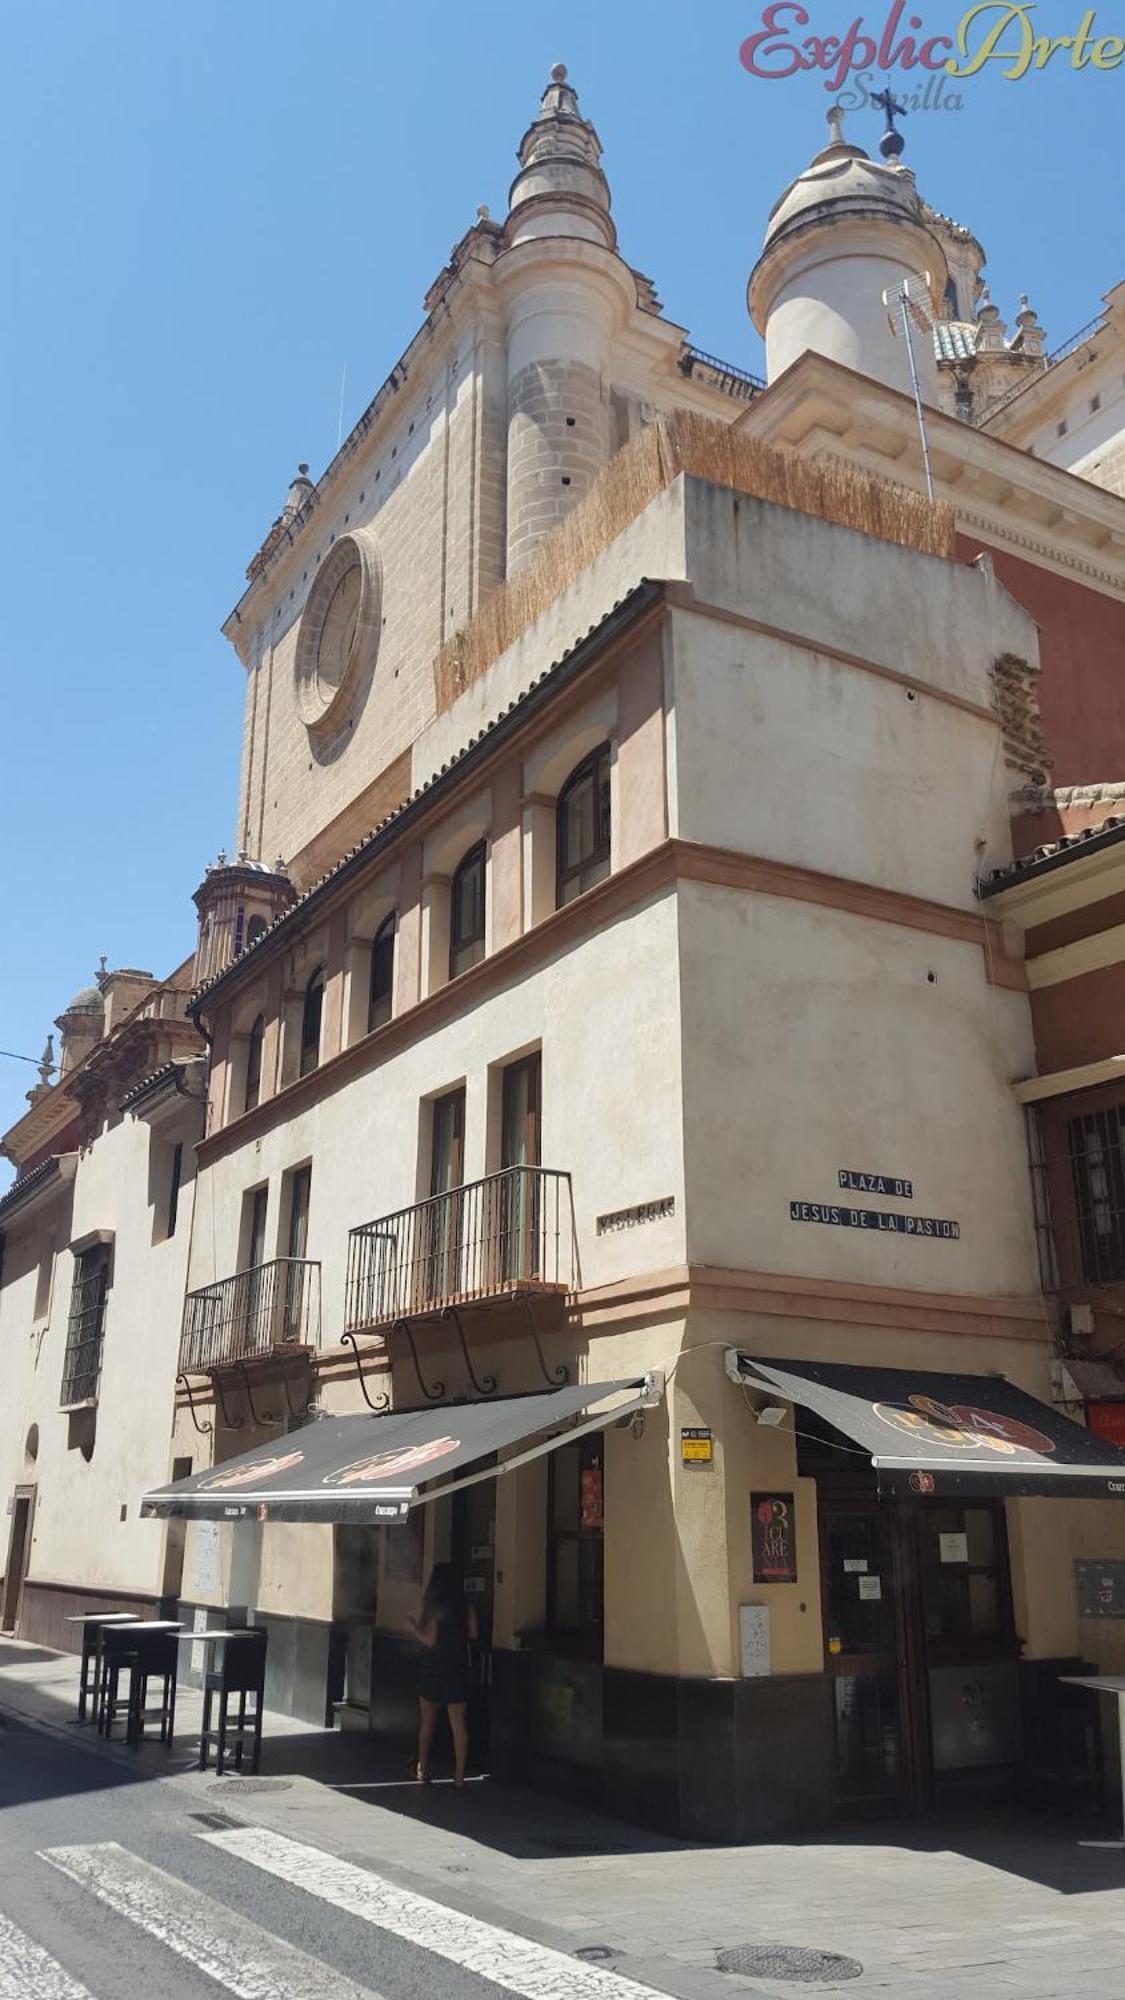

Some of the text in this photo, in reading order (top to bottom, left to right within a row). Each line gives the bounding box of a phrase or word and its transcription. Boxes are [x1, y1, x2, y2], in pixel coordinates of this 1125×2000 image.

[840, 1171, 911, 1197] PLAZA DE
[792, 1204, 959, 1239] JESUS DE LA PASION
